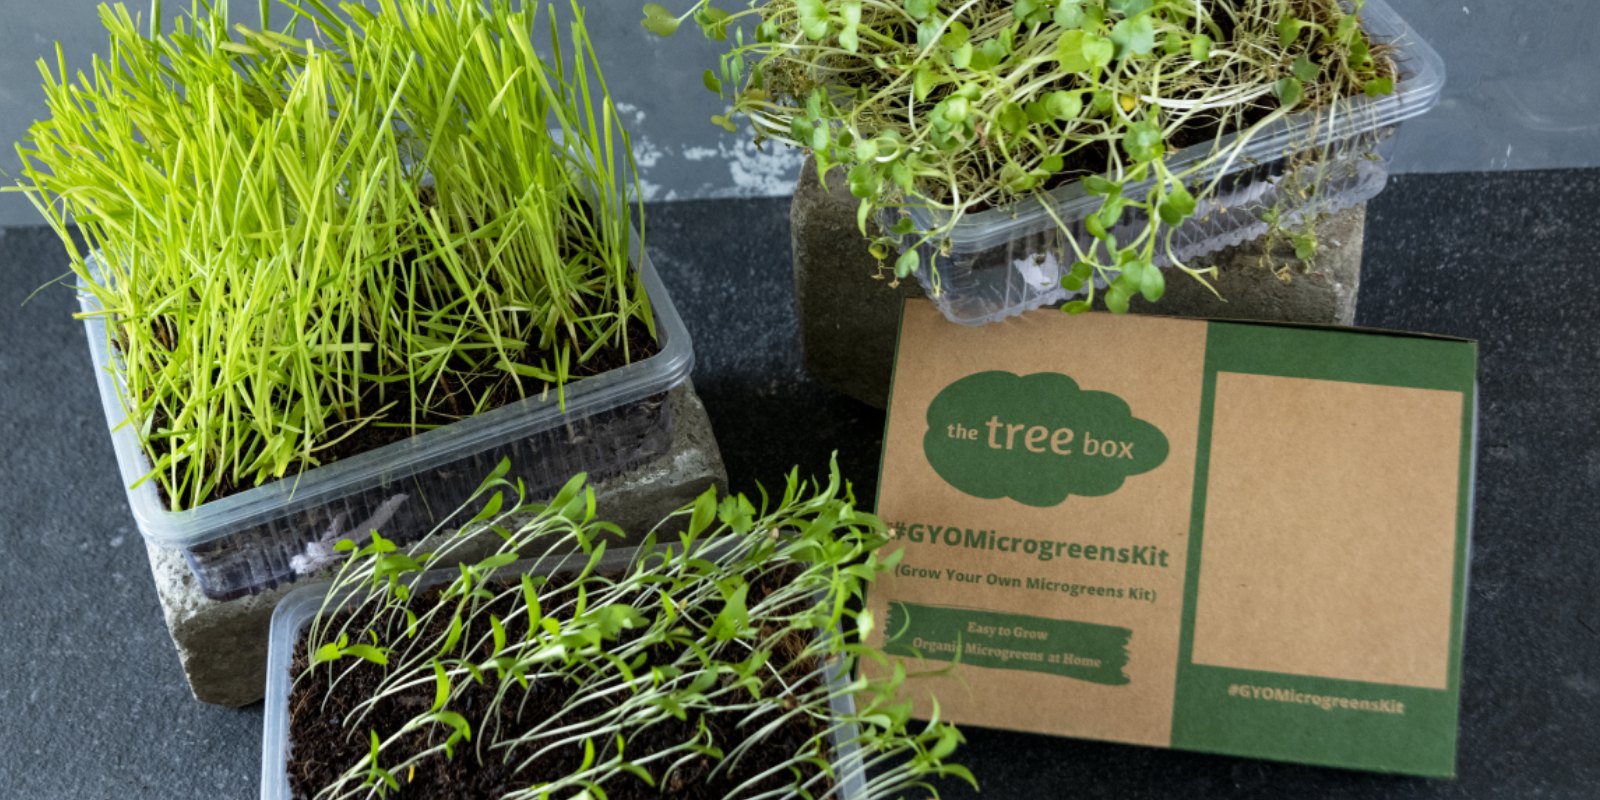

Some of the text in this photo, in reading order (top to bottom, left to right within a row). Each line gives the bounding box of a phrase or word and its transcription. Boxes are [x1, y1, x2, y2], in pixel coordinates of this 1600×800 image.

[947, 416, 1134, 459] the tree box
[888, 521, 1169, 568] #GYOMicrogreensKit
[895, 564, 1157, 602] (Grow Your Own Microgreens Kit)
[967, 621, 1048, 641] Easy to Grow
[912, 637, 1102, 668] Organi Microgreens at Home
[1228, 684, 1405, 714] #GYOMicrogreensKit
